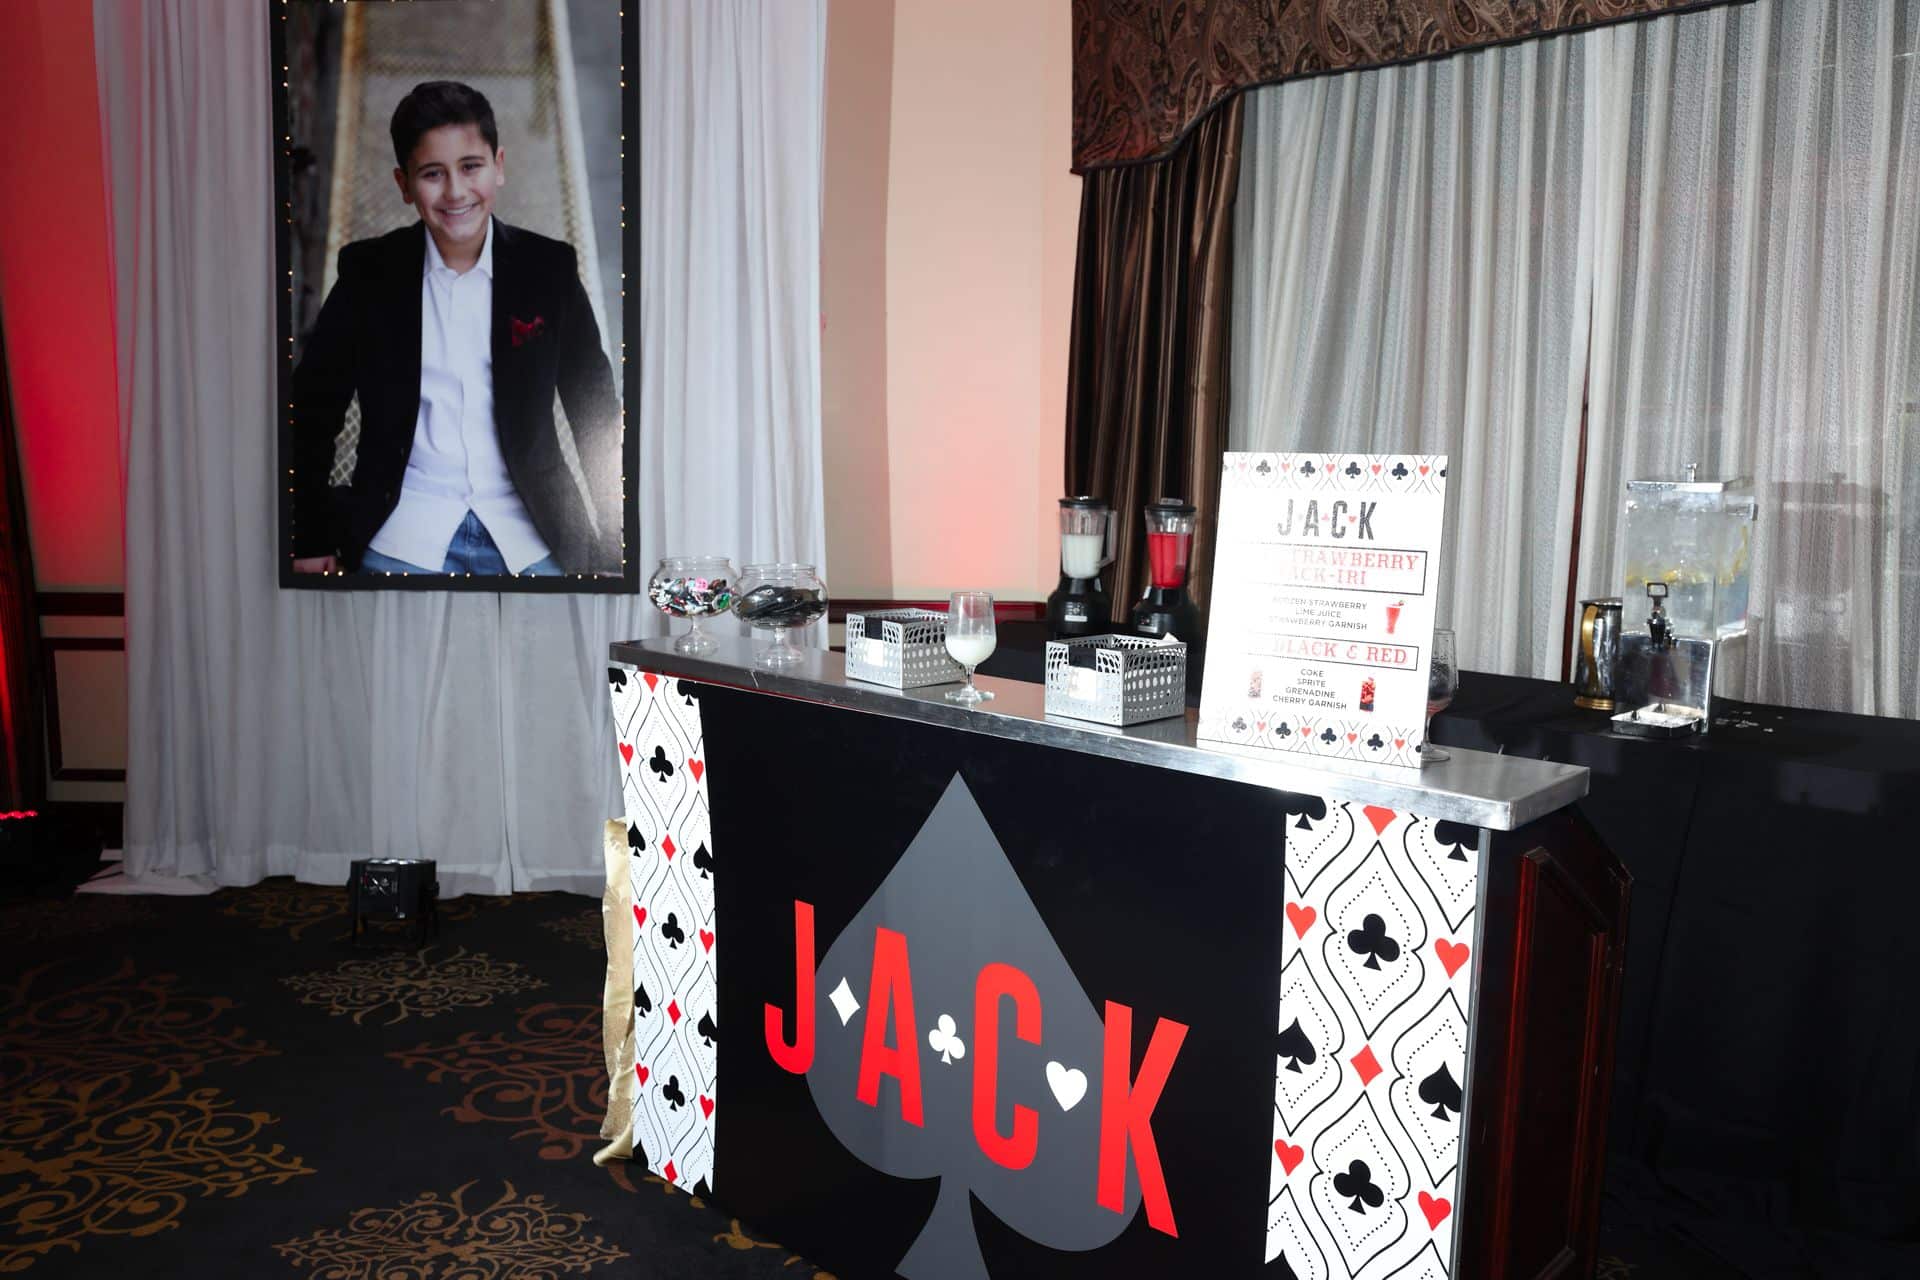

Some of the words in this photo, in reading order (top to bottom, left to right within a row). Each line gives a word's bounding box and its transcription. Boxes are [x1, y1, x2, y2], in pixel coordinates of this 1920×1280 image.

[1278, 498, 1377, 540] JACK
[1280, 549, 1419, 571] TRAWBERRY
[1281, 566, 1367, 585] ACK-IRI
[1309, 599, 1368, 611] STRAWBERRY
[1317, 609, 1342, 619] JUICE
[1328, 619, 1368, 630] GARNISH
[1367, 645, 1408, 664] RED
[1300, 668, 1325, 678] COKE
[1297, 678, 1327, 688] SPRITE
[1285, 686, 1337, 699] GRENADINE
[1272, 694, 1307, 705] CHERRY
[1308, 698, 1348, 710] GARNISH
[764, 899, 1190, 1239] JACK
